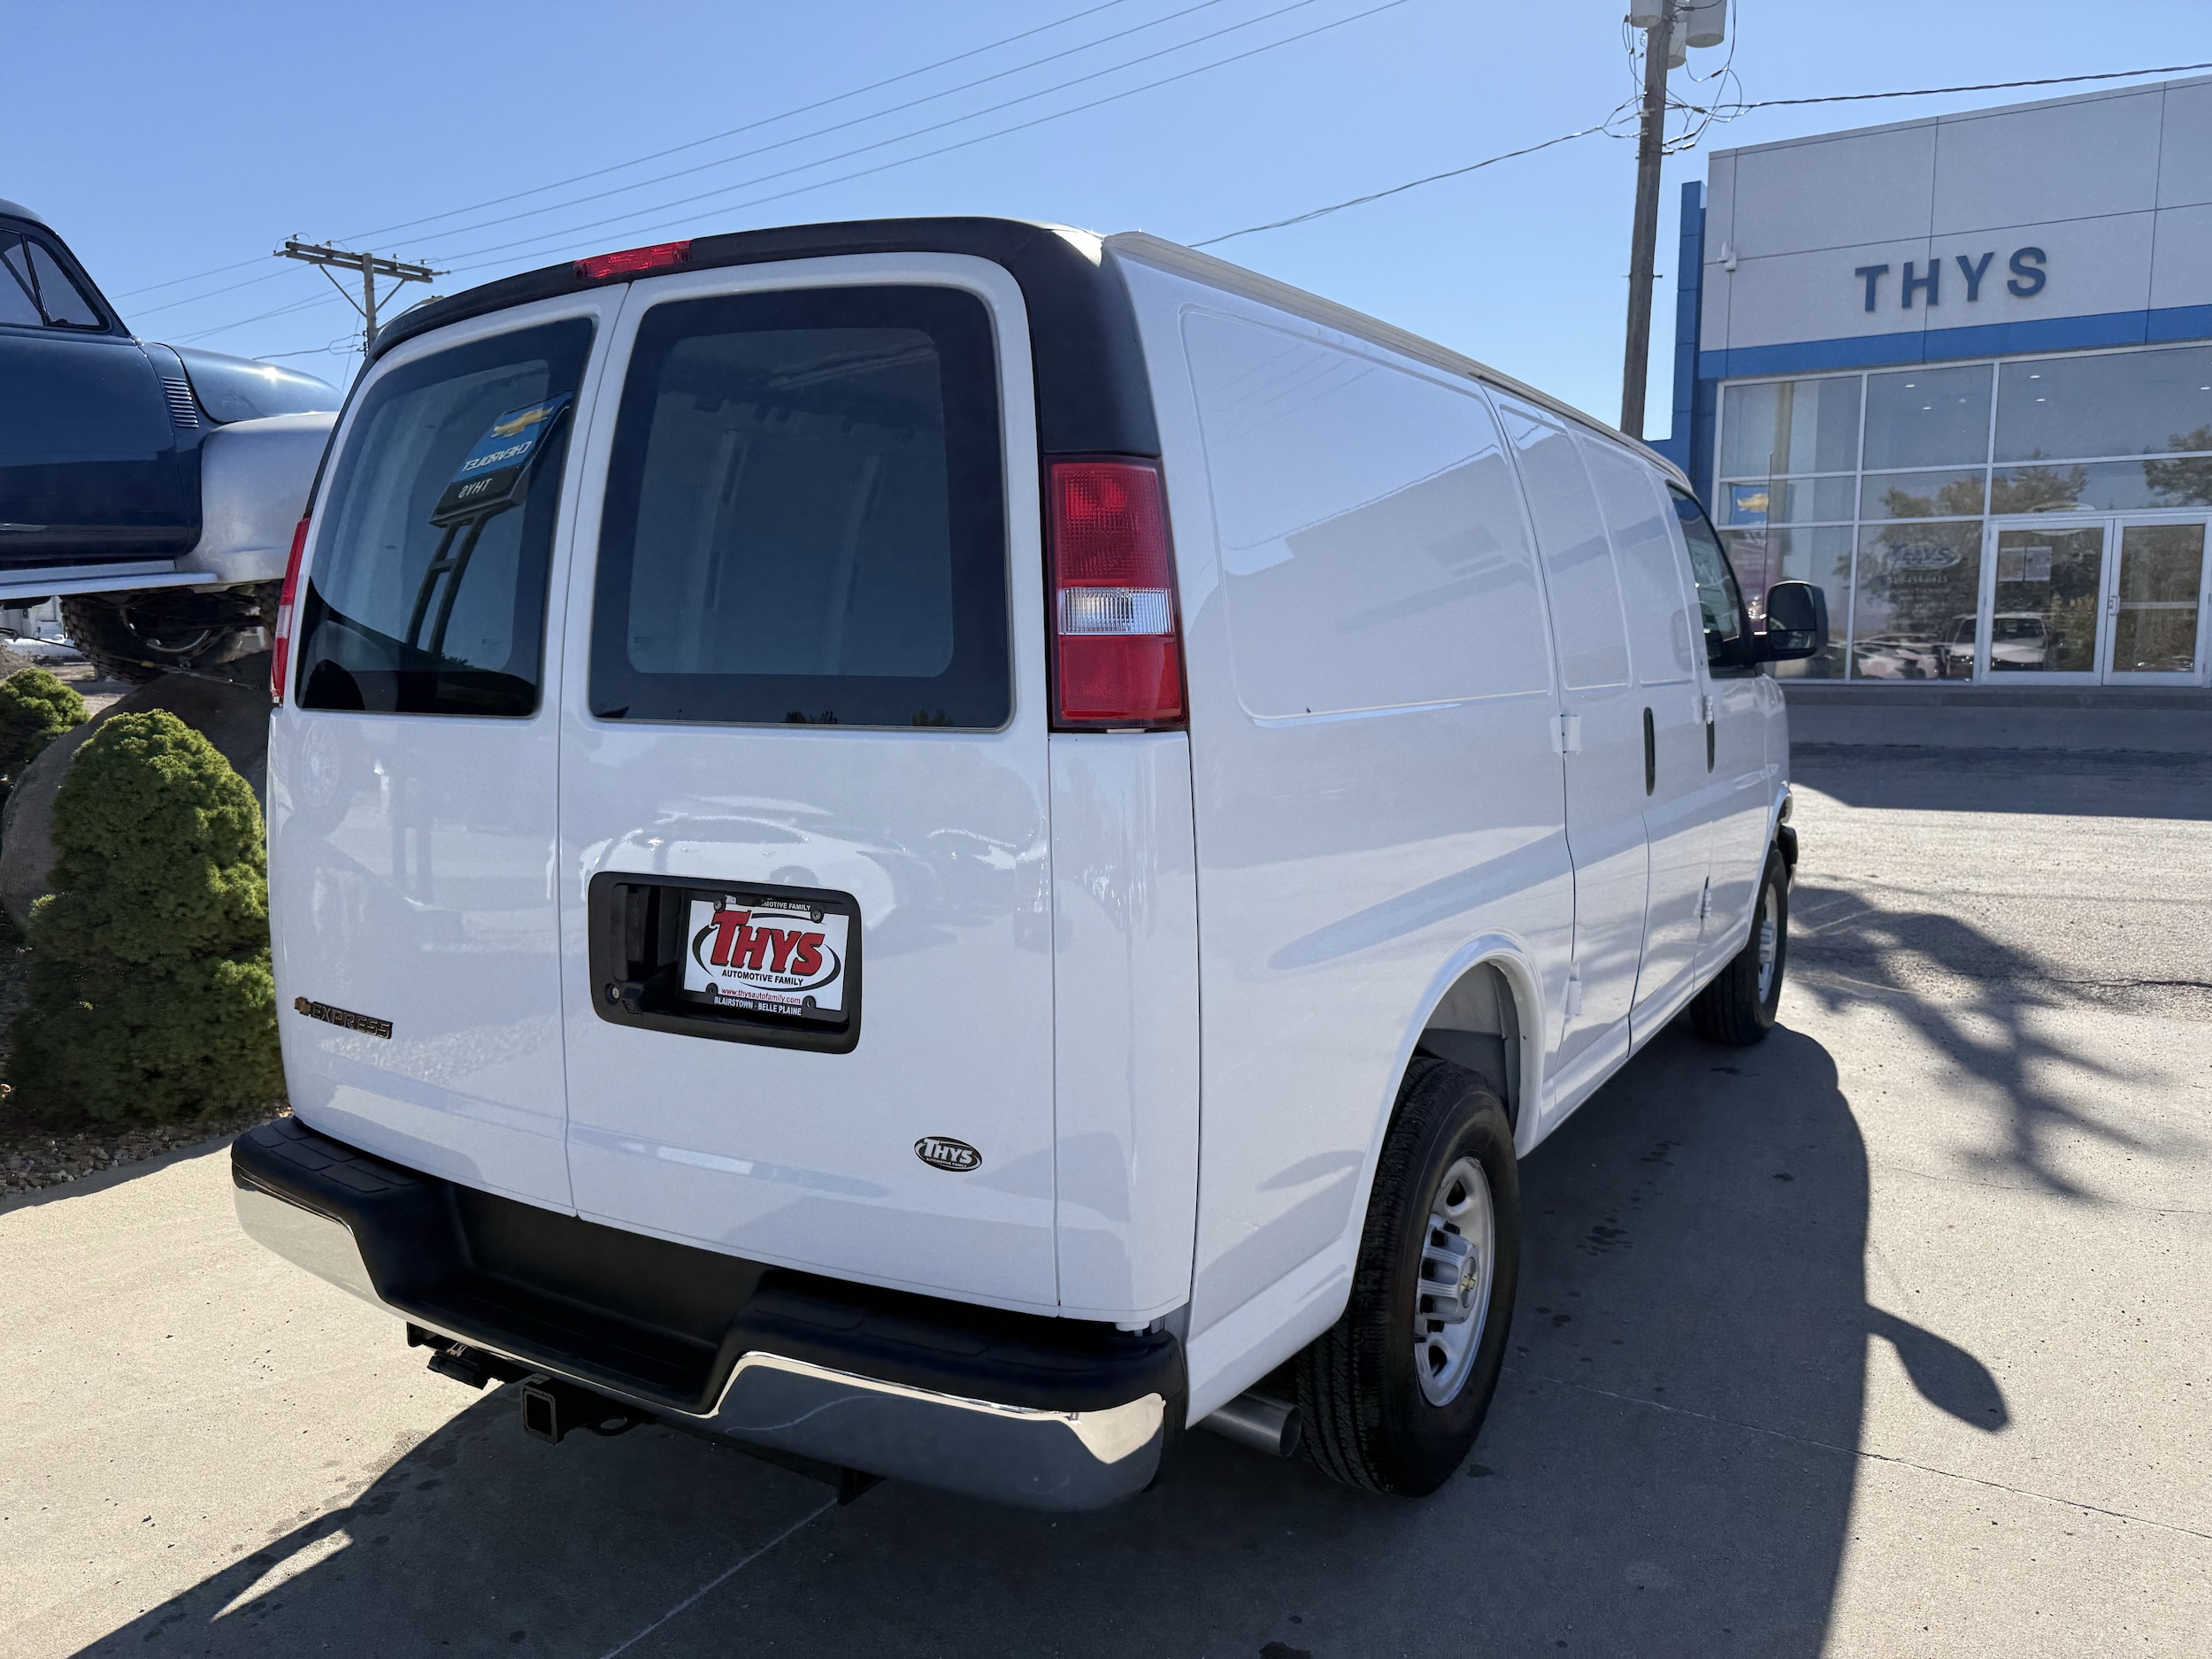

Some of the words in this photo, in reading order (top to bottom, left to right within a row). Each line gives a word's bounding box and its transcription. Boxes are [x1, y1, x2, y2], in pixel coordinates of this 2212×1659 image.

[1855, 246, 2047, 312] THYS
[788, 902, 811, 911] FAMILY
[710, 910, 826, 976] THYS
[721, 969, 773, 983] AUTOMOTIVE
[774, 975, 804, 987] FAMILY
[714, 996, 754, 1010] BLAIRSTOWN
[757, 1002, 778, 1013] BELLE
[779, 1005, 803, 1016] PLAINE
[721, 987, 801, 1004] www.thysautofamily.com
[311, 1002, 392, 1039] EXPRESS
[924, 1138, 972, 1164] THYS
